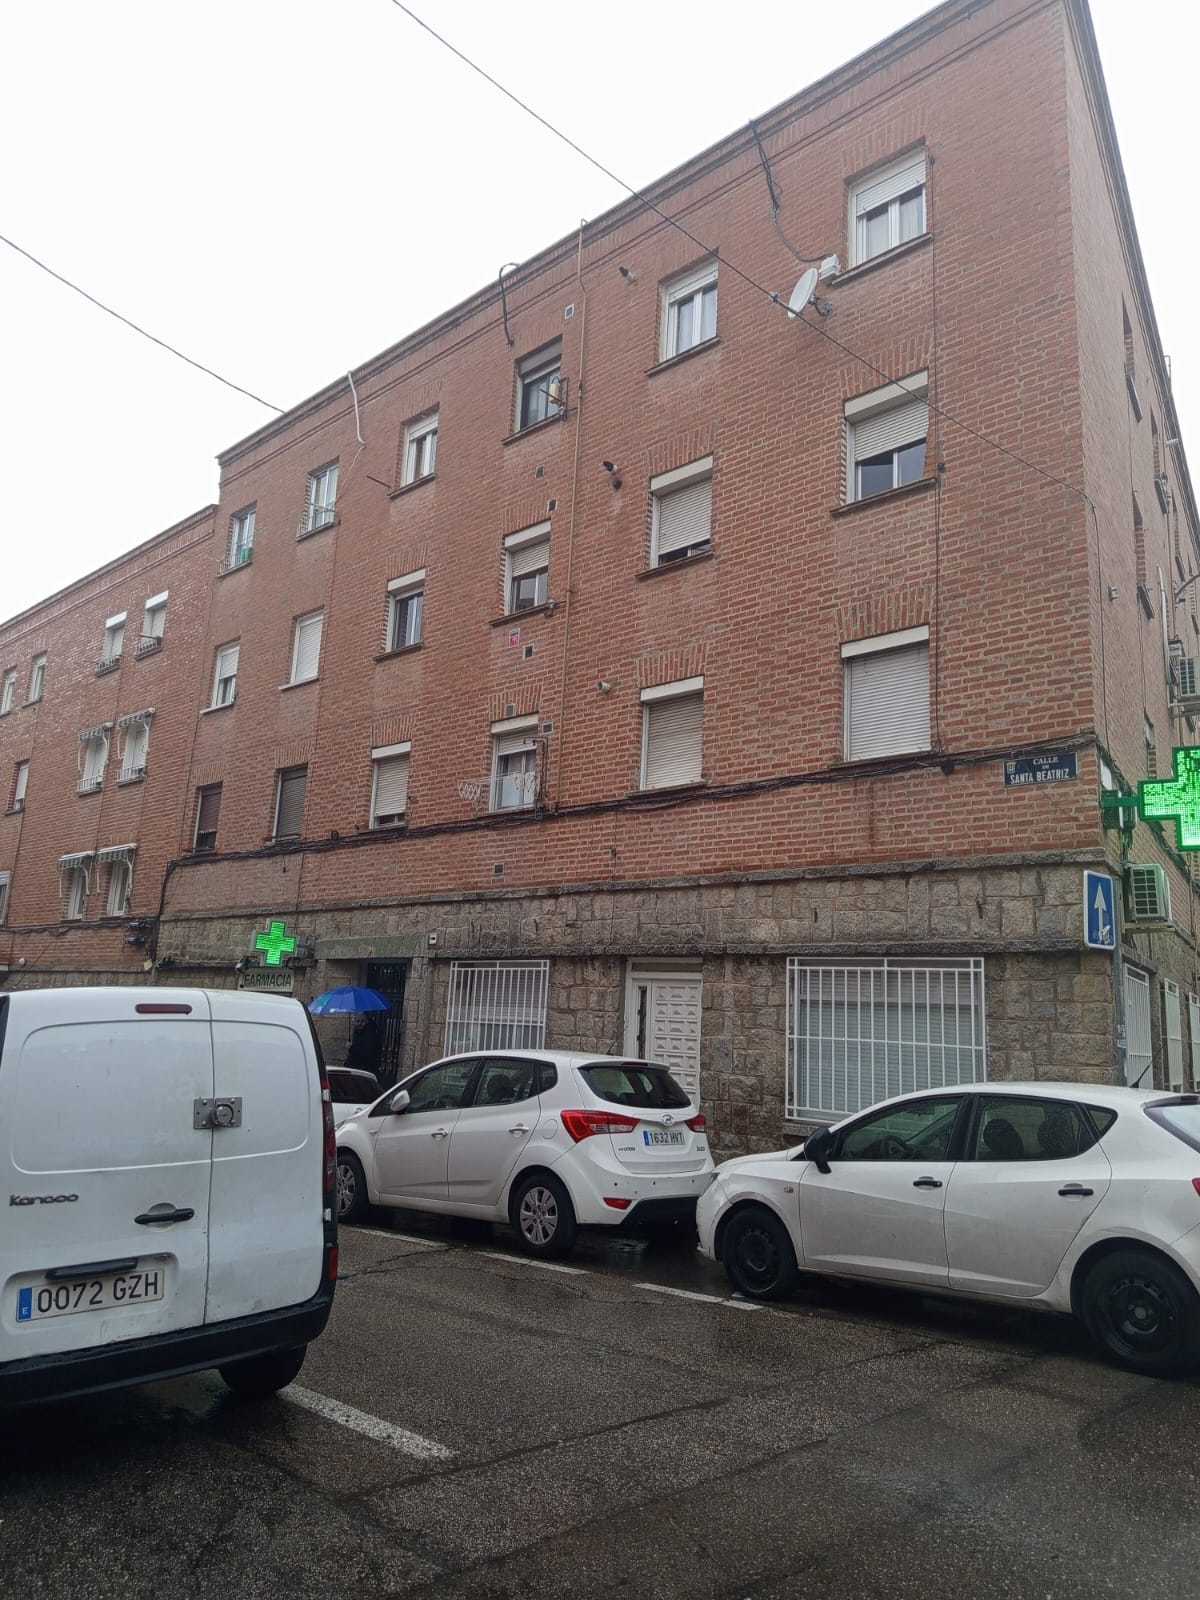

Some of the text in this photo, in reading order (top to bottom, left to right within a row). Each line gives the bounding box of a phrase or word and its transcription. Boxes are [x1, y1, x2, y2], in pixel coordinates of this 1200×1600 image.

[1033, 756, 1059, 765] CALLE
[1010, 768, 1069, 784] SANTA BEATRIZ
[243, 974, 292, 987] FARMACIA
[649, 1131, 669, 1144] 1632
[38, 1281, 103, 1313] 0072
[113, 1272, 158, 1301] GZH
